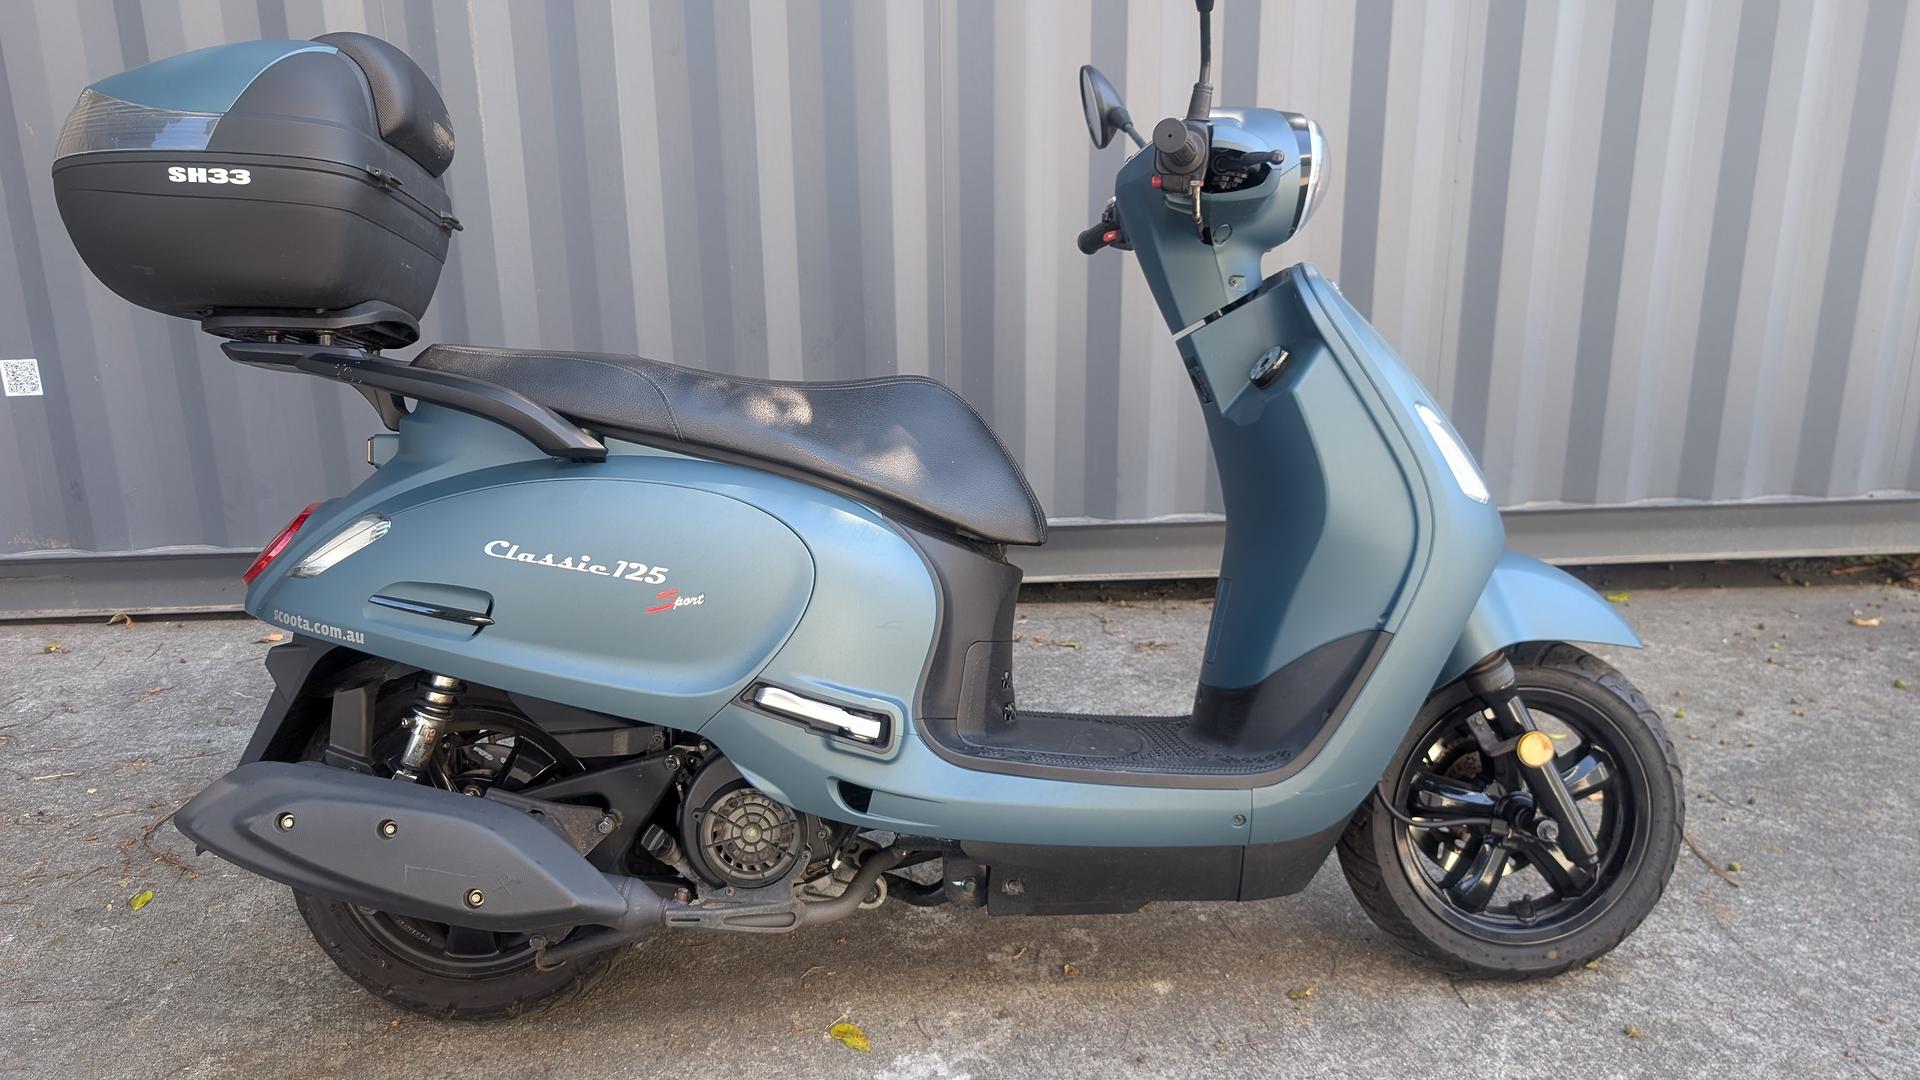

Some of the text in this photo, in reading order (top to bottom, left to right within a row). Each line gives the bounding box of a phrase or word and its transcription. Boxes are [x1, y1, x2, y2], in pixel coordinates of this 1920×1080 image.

[168, 166, 251, 185] SH33
[484, 540, 669, 585] Classic 125
[645, 588, 705, 614] Sport
[273, 609, 365, 645] scoota.com.au
